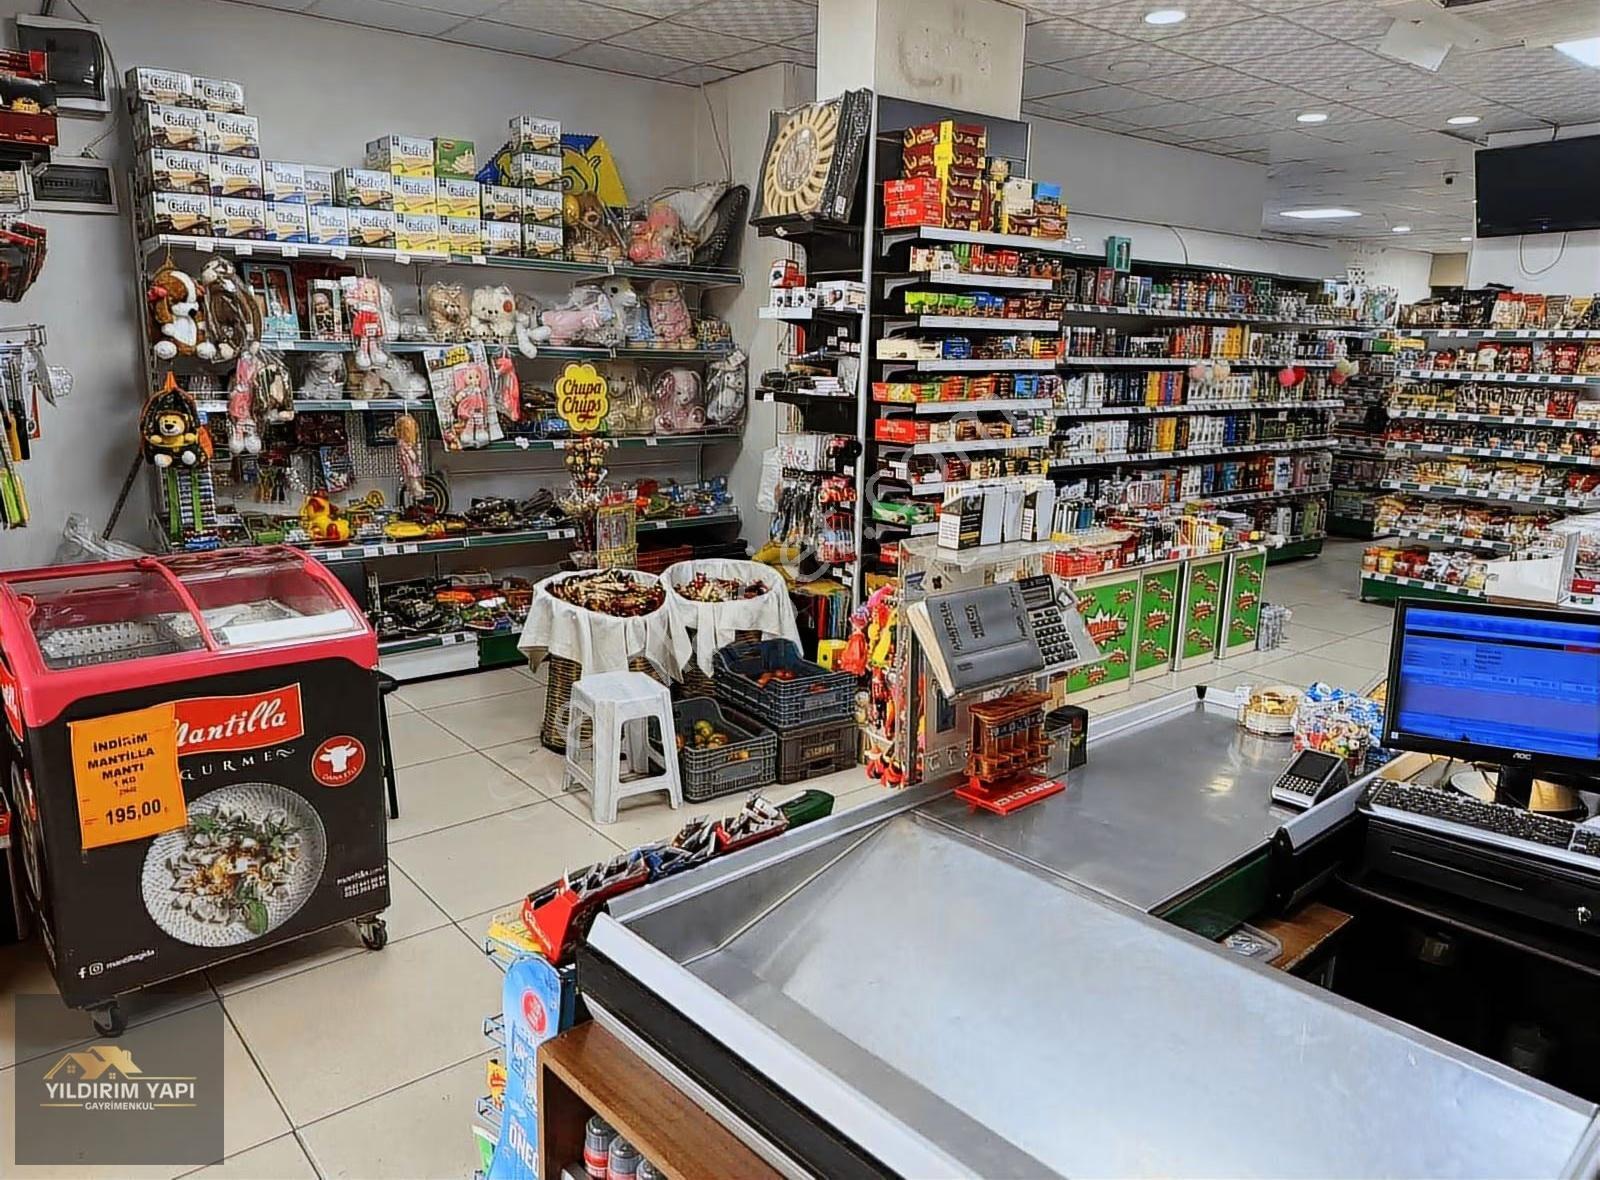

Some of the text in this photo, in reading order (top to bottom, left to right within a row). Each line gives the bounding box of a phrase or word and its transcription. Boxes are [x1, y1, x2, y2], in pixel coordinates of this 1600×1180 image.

[562, 379, 602, 398] Chupa
[562, 397, 601, 414] Chups
[1512, 752, 1532, 761] AOC
[101, 764, 145, 781] MANTI
[105, 798, 161, 826] 195,00
